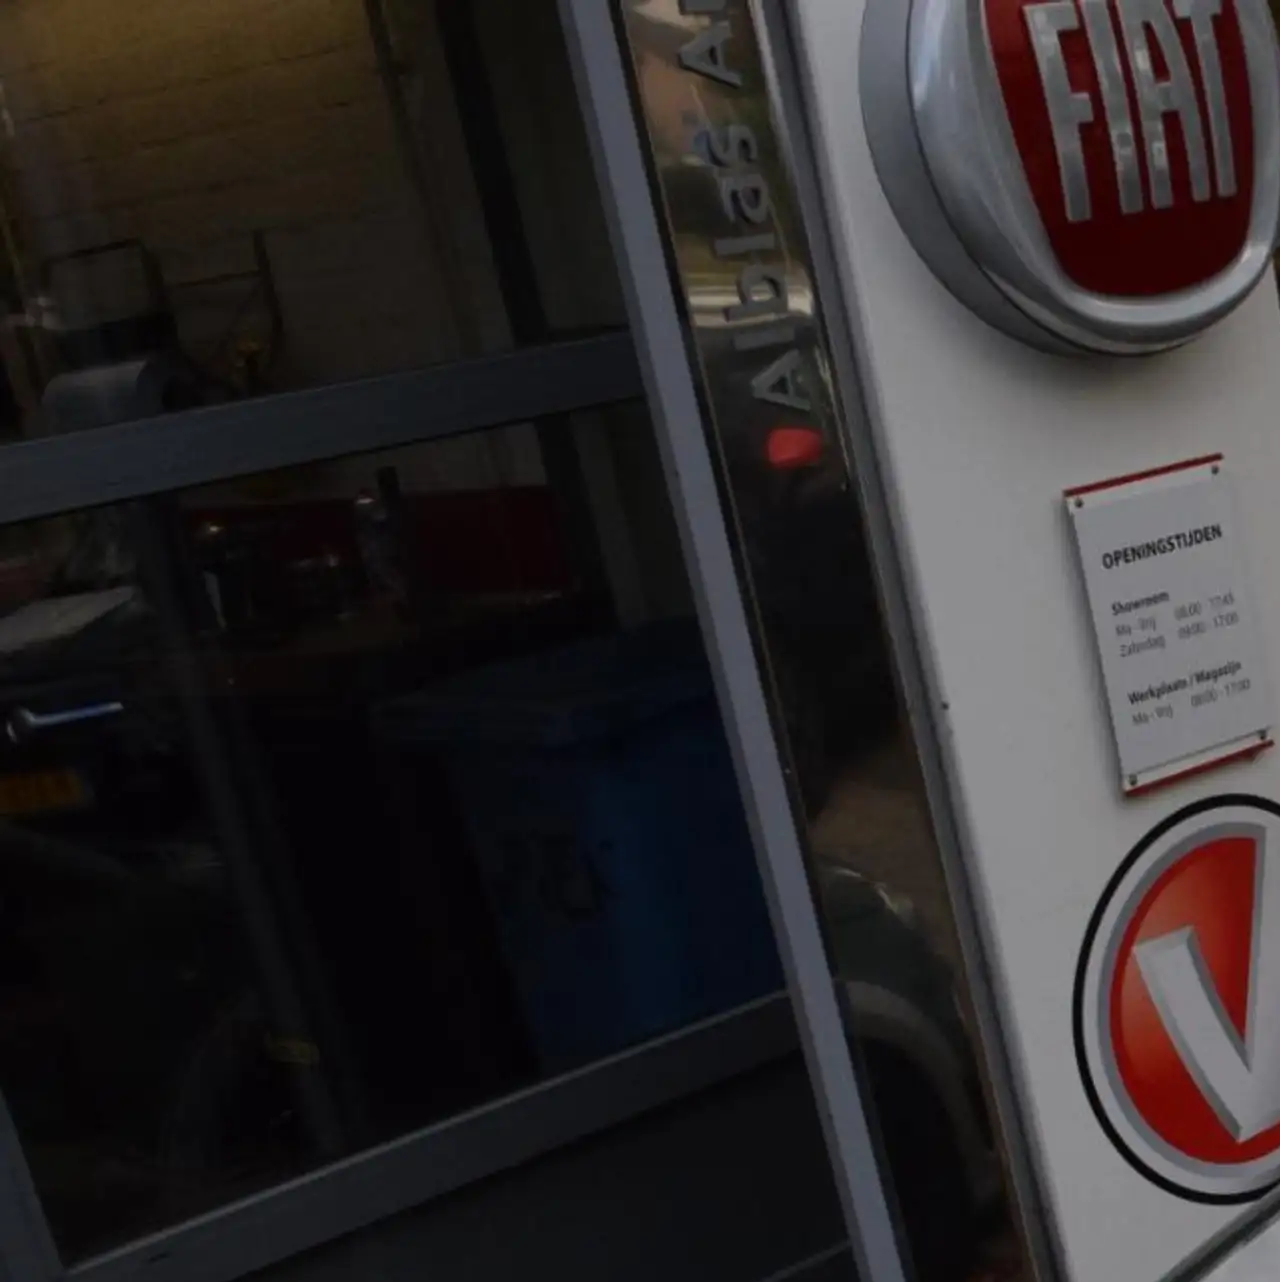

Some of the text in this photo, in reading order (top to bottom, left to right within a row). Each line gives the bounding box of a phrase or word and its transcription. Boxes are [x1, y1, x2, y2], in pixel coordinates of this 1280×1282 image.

[1022, 0, 1237, 223] FIAT
[679, 0, 812, 412] Alblas A
[1102, 524, 1222, 569] OPENINGSTIJDEN
[1112, 591, 1170, 616] Showroom
